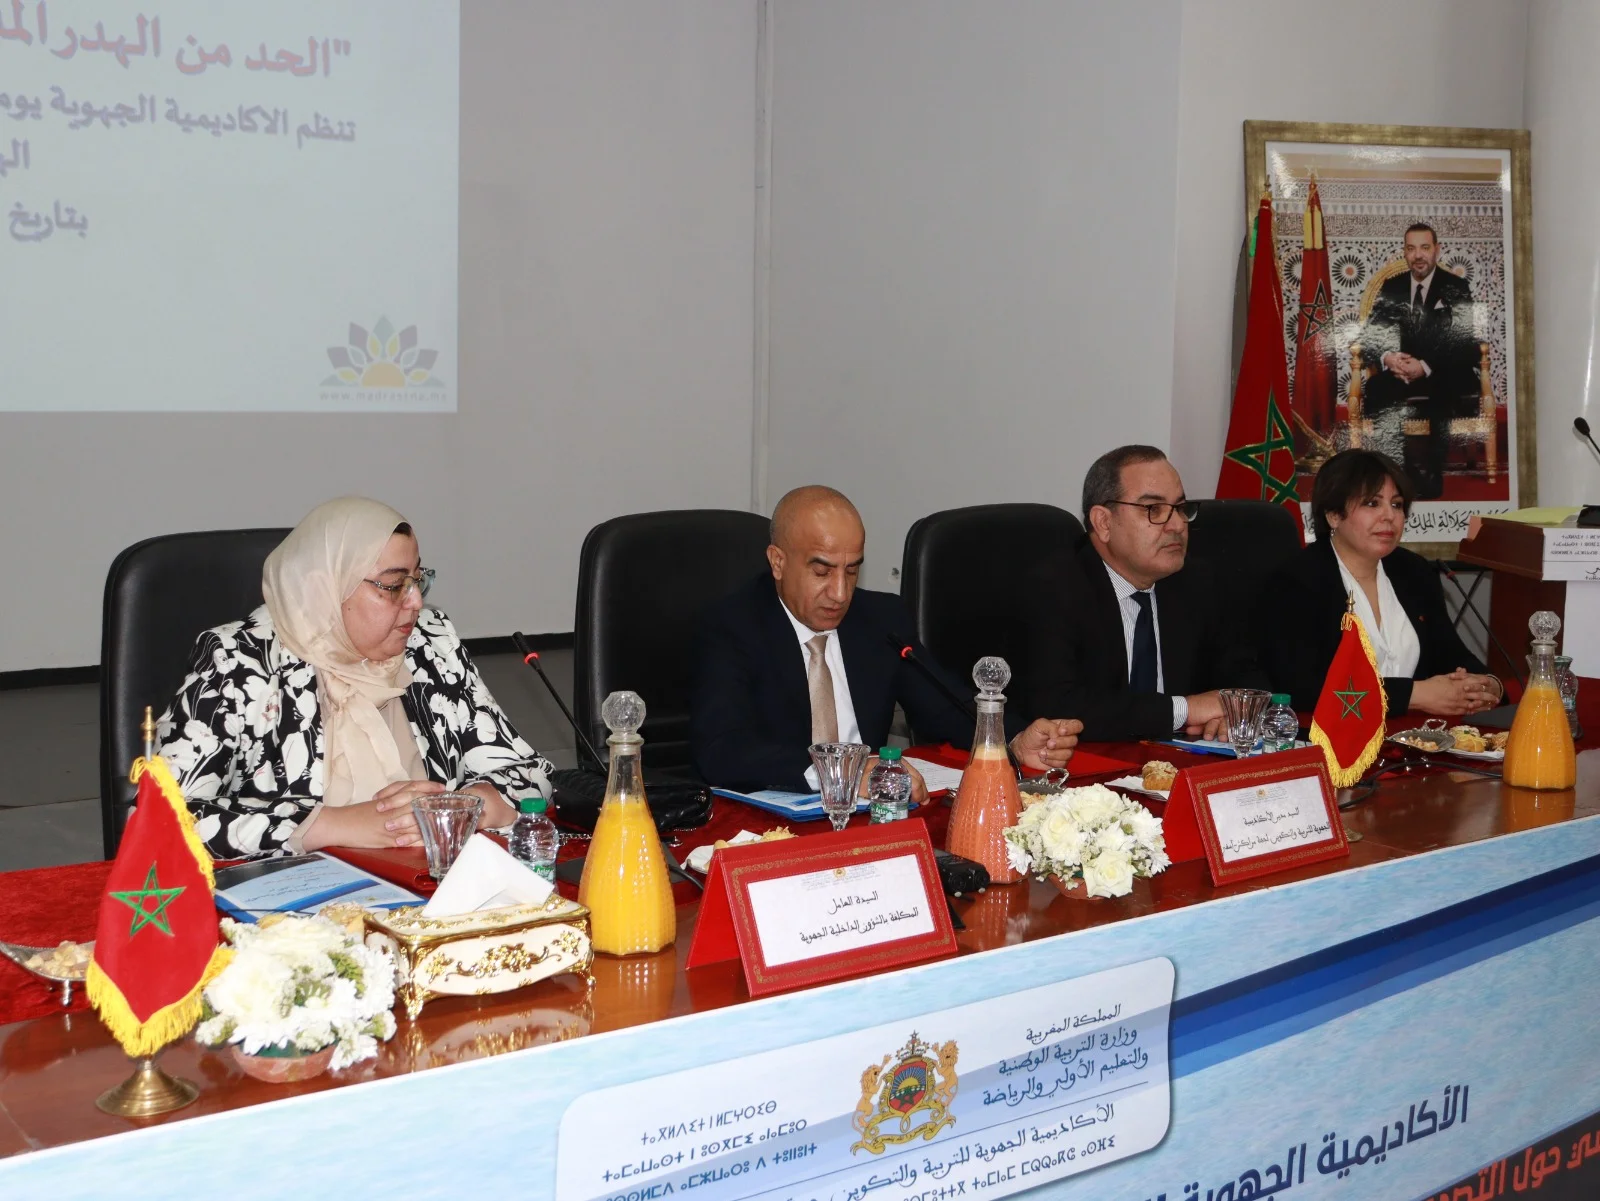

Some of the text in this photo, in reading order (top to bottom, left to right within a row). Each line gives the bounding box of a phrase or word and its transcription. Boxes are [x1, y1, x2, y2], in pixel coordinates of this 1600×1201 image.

[0, 0, 47, 46] الم
[50, 13, 162, 69] الهدر
[175, 34, 232, 75] من
[49, 85, 156, 129] الجهوية
[164, 97, 290, 137] الاكاديمية
[297, 112, 356, 149] تنظم
[8, 200, 89, 242] بتاريخ
[828, 890, 879, 915] السيدة العامل
[799, 906, 919, 944] المكلفة بالشؤون الداخلية الجهوية
[1026, 1003, 1121, 1045] المملكة المغربية
[998, 1026, 1138, 1077] وزارة التربية الوطنية
[983, 1047, 1149, 1107] والتعليم الأولي والرياضة
[1031, 1102, 1115, 1145] الأكاديمية
[1316, 1084, 1470, 1180] الأكاديمية
[923, 1147, 971, 1180] للتربية
[975, 1129, 1026, 1162] الجهوية
[1512, 1145, 1562, 1193] حول
[606, 1181, 675, 1201] ⵙⵙⵍⵎⴷ
